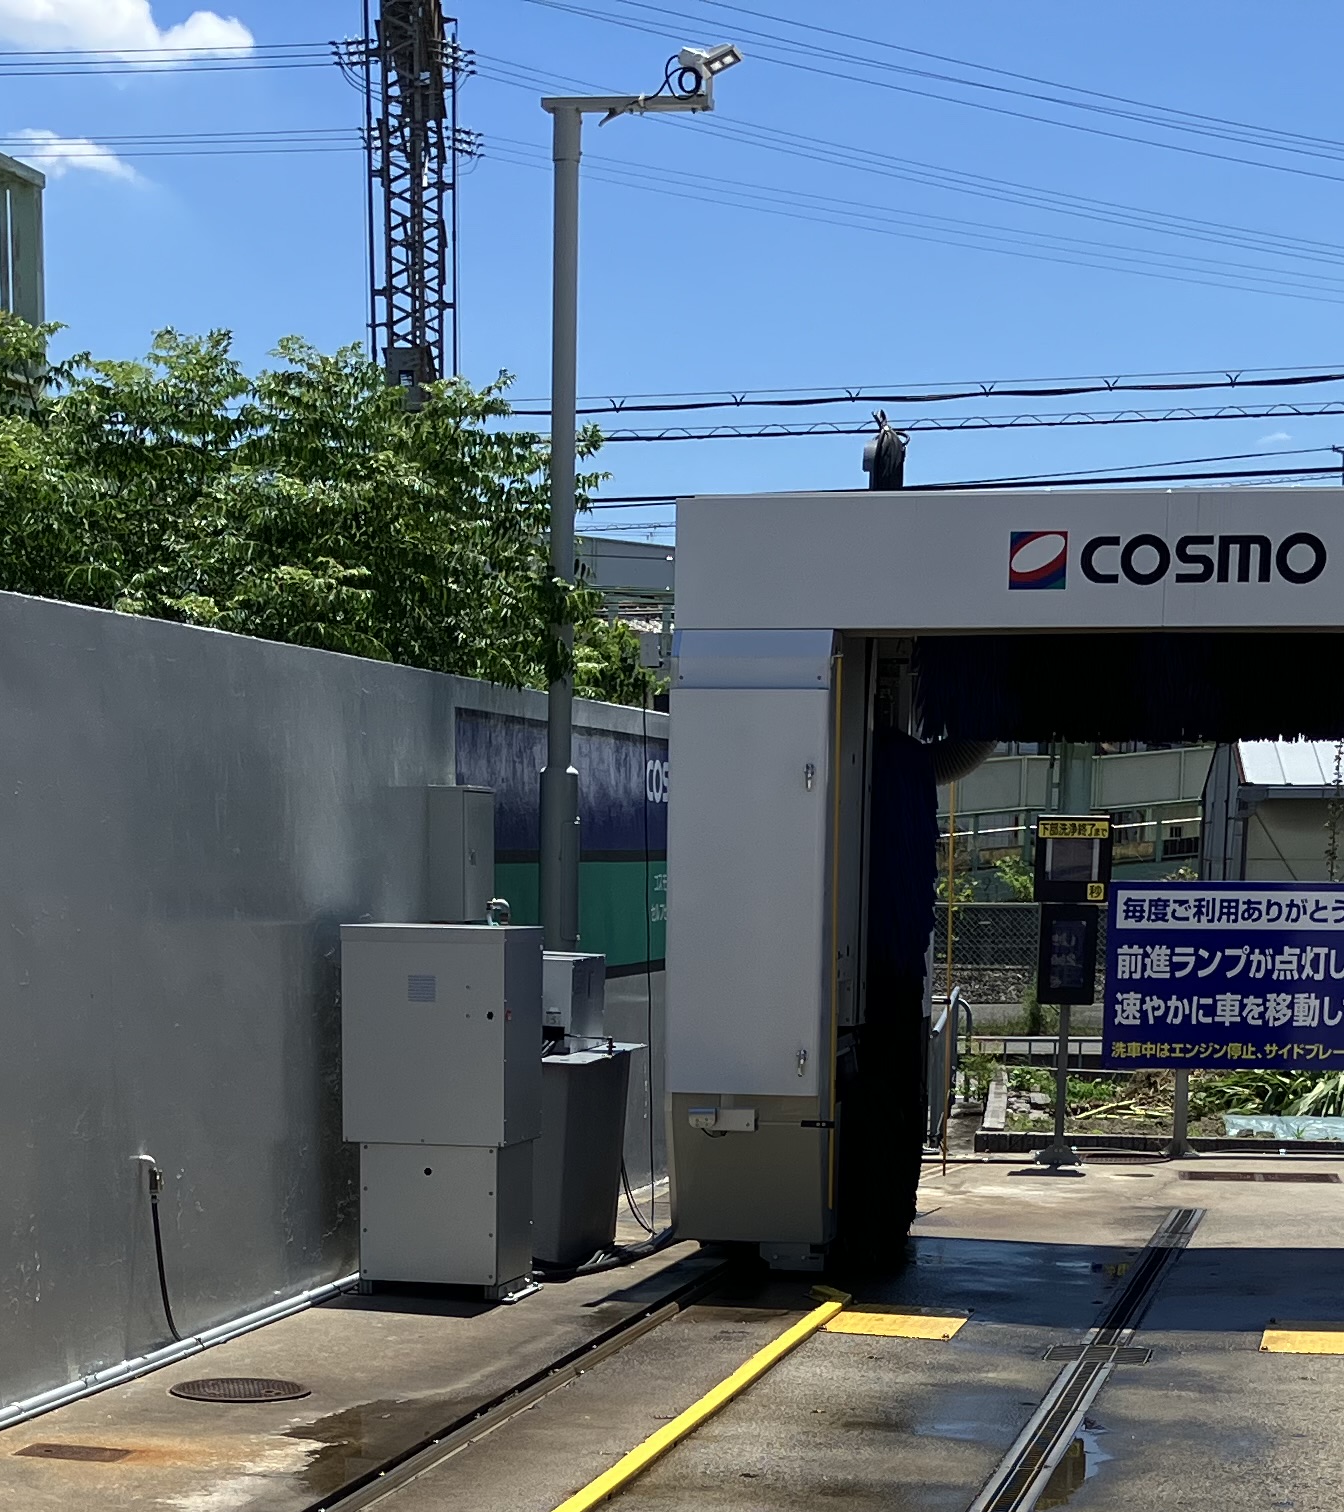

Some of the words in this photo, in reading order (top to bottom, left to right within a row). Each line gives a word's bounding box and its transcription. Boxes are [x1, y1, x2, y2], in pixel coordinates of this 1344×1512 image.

[1080, 532, 1327, 586] COSMO
[1040, 822, 1107, 837] 下部洗浄終了まで
[1089, 885, 1102, 899] 秒
